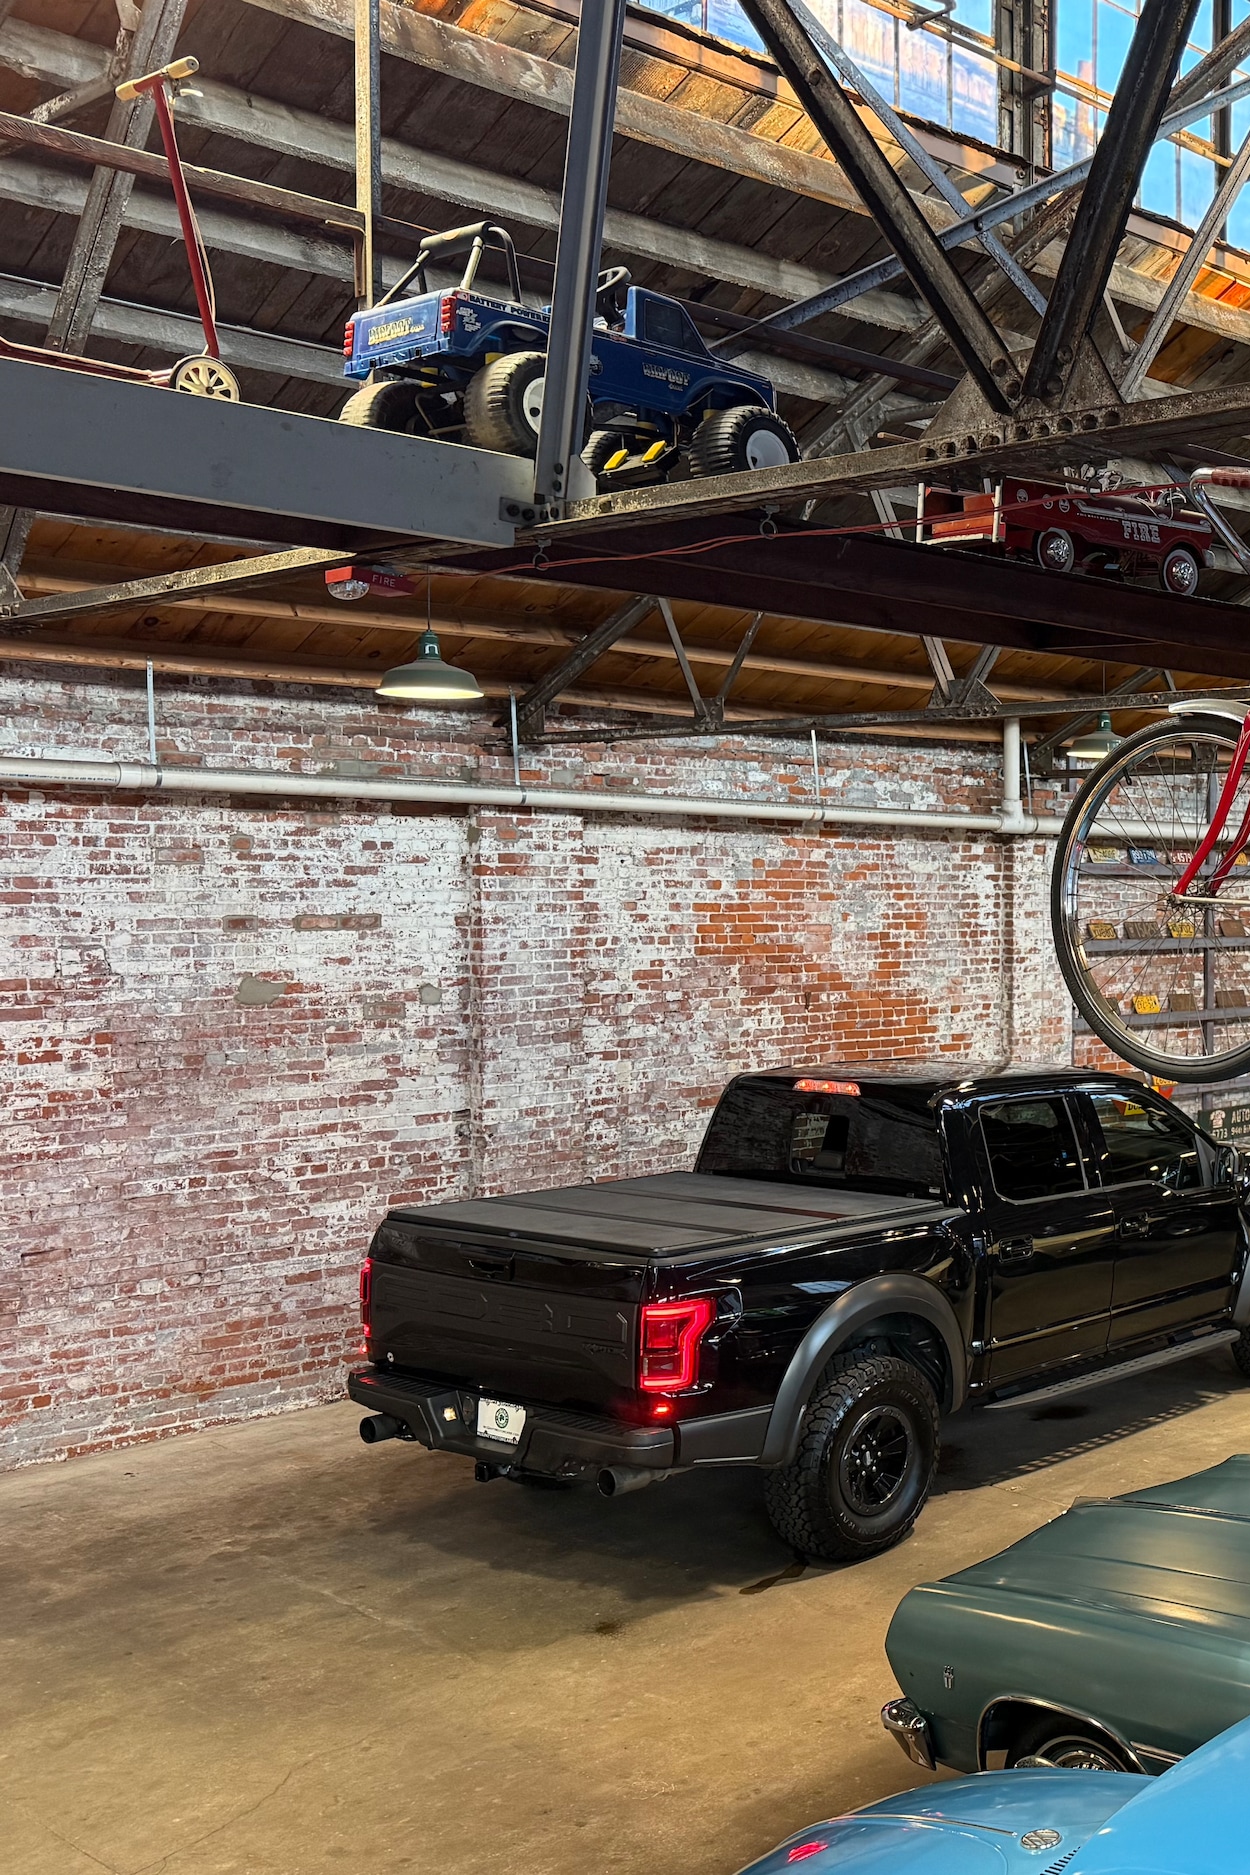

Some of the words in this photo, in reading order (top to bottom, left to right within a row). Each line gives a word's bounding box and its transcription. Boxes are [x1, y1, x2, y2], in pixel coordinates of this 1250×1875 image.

[470, 294, 507, 312] BATTERY
[1122, 520, 1161, 543] FIRE
[372, 574, 396, 587] FIRE
[1231, 1108, 1250, 1124] AUTO
